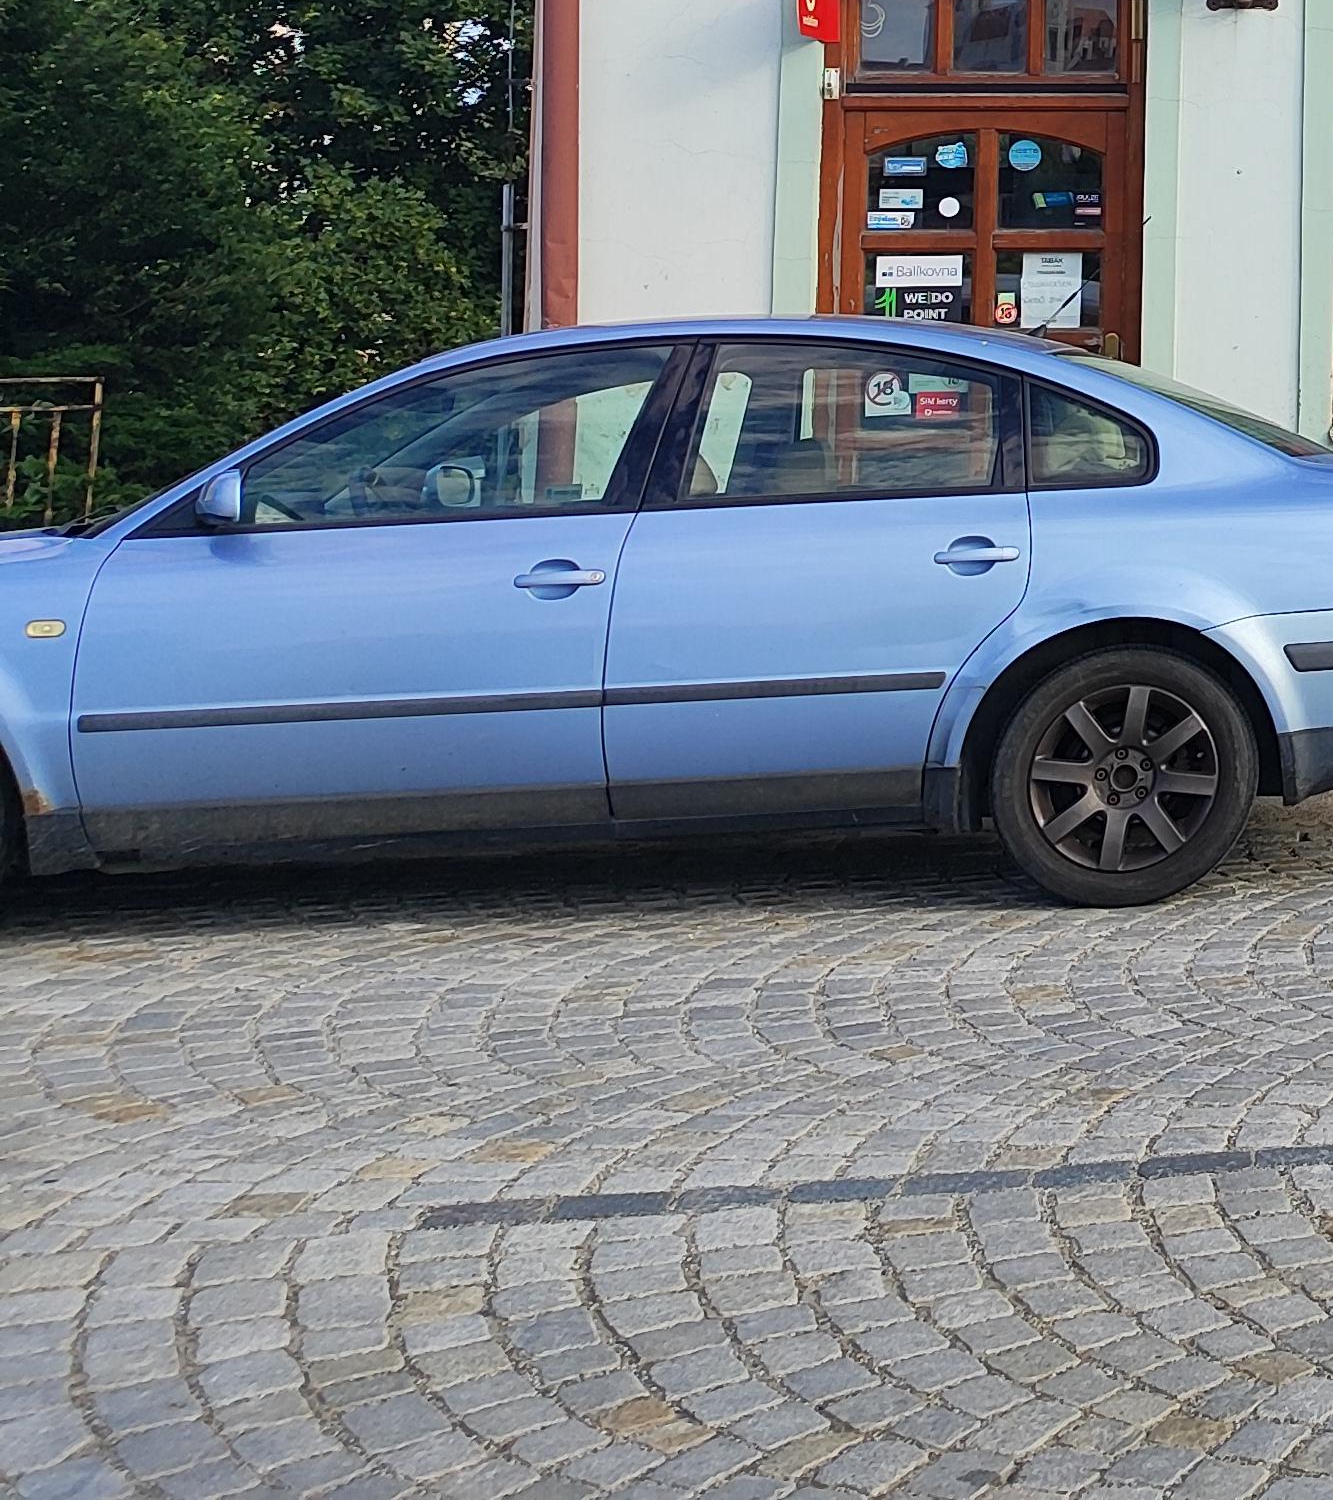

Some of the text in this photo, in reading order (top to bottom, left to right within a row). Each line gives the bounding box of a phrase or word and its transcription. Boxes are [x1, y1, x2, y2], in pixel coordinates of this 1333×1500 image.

[896, 265, 958, 277] Balíkovna
[903, 308, 949, 320] POINT
[873, 380, 895, 396] 18
[920, 397, 935, 405] SIM
